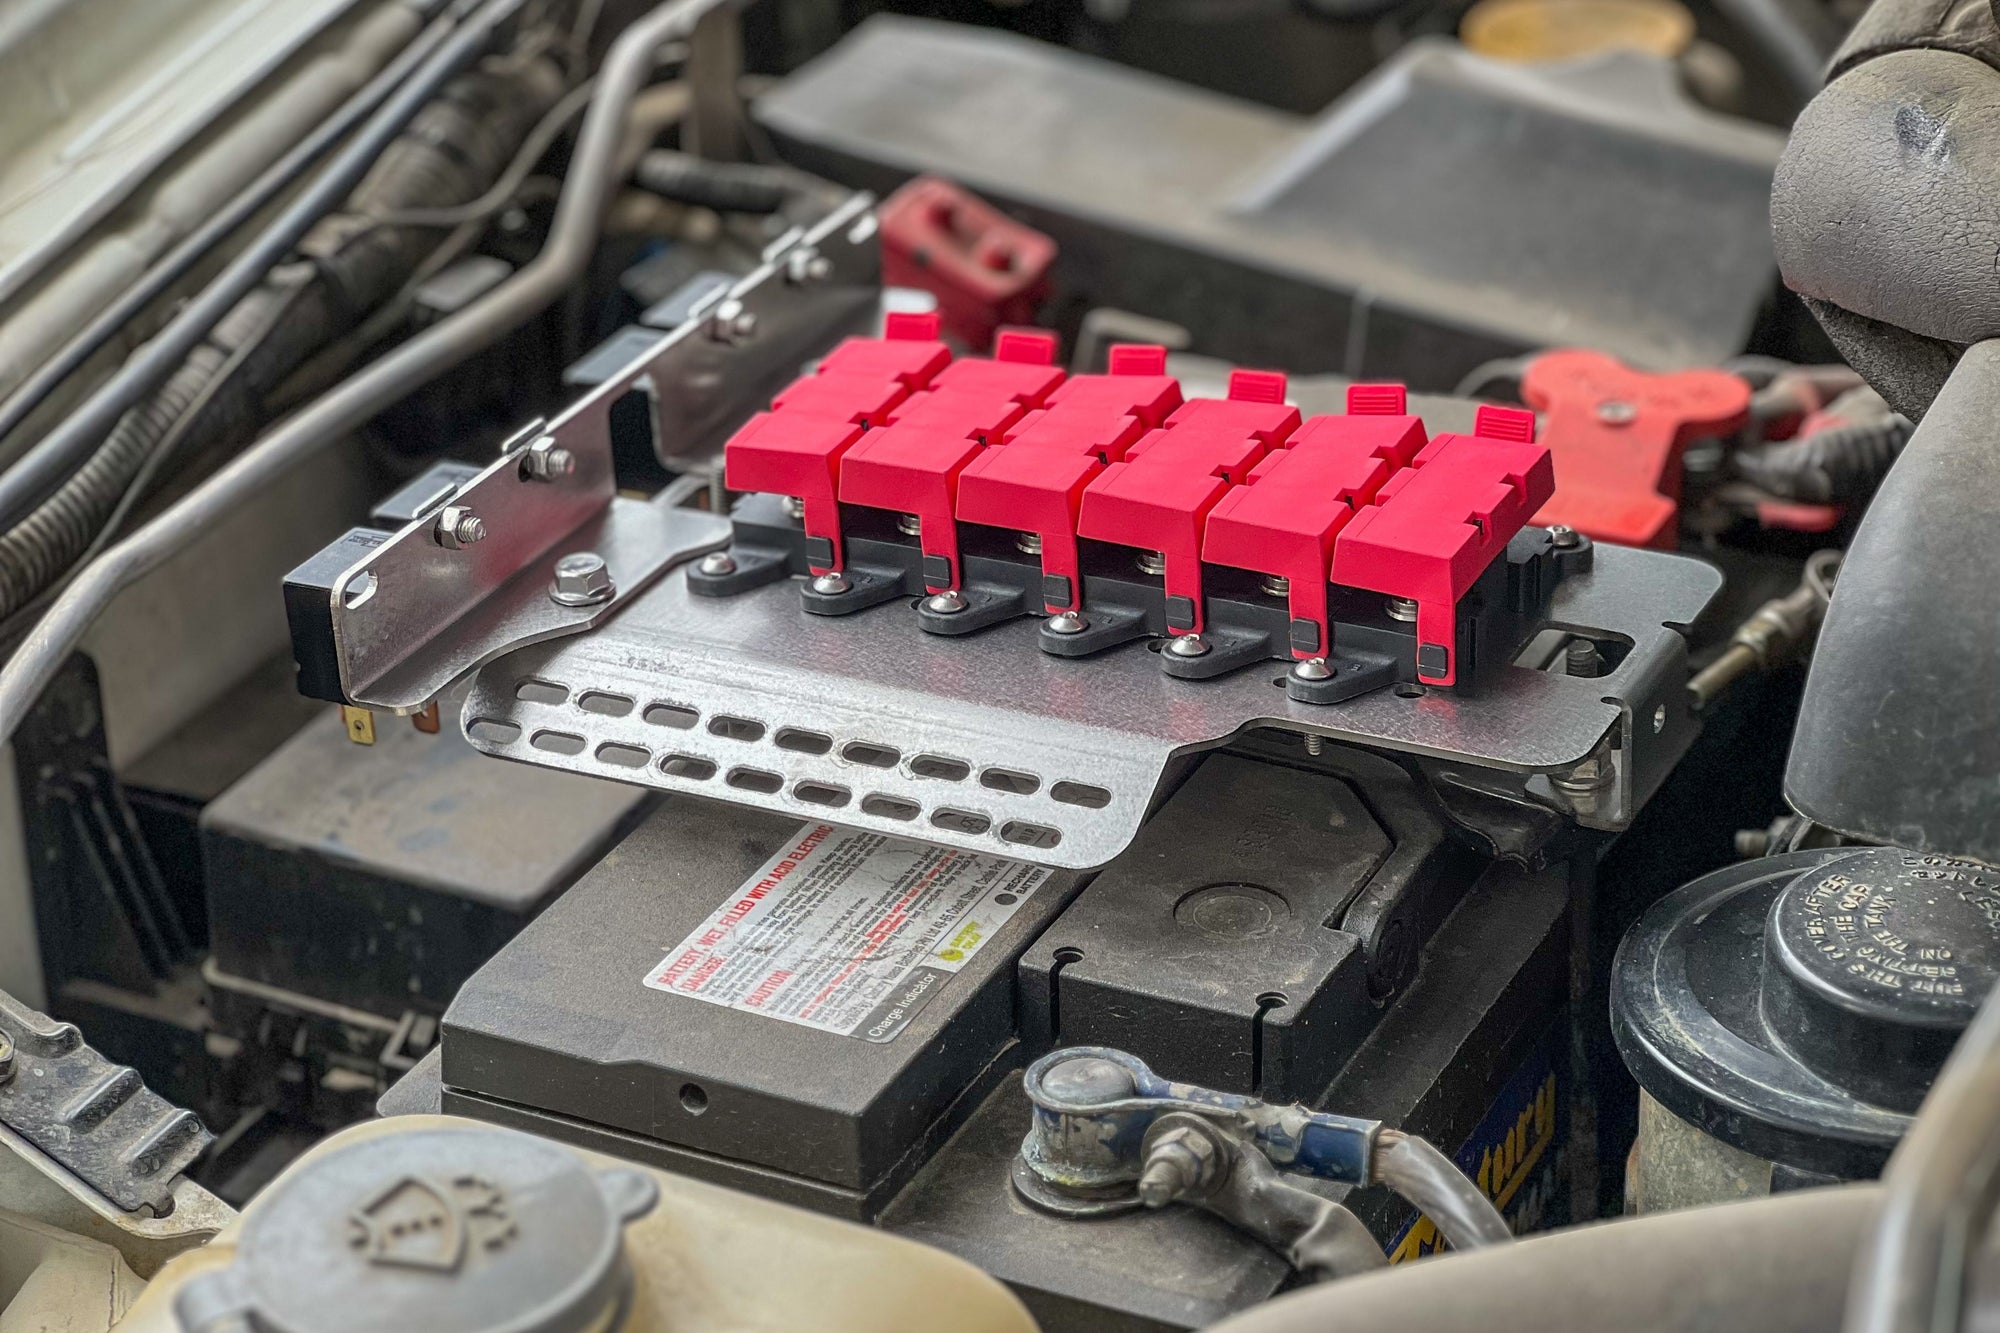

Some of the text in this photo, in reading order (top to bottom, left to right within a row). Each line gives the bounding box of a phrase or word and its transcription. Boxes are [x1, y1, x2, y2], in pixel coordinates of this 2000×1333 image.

[717, 899, 757, 926] FILLED
[744, 879, 778, 900] WITH
[765, 860, 798, 880] ACID
[786, 824, 835, 860] ELECTRIC
[765, 897, 790, 916] generate
[784, 878, 810, 897] explosive
[819, 852, 837, 863] Keep
[774, 908, 791, 919] from
[815, 861, 840, 879] charging
[791, 904, 807, 914] This
[801, 888, 822, 904] battery
[816, 871, 841, 889] contains
[814, 890, 832, 902] event
[831, 867, 856, 885] accident
[861, 846, 877, 856] with
[932, 873, 946, 882] the
[939, 859, 960, 874] battery
[1014, 869, 1046, 894] BATTERY
[828, 932, 852, 949] product
[850, 906, 878, 928] warranted
[871, 890, 894, 906] against
[887, 874, 910, 890] defects
[917, 846, 938, 860] period
[855, 914, 881, 935] purchase
[881, 893, 903, 908] private
[864, 918, 890, 938] Warranty
[888, 903, 905, 913] void
[892, 919, 914, 935] battery
[907, 910, 923, 919] test
[916, 887, 945, 910] procedure.
[930, 913, 956, 929] 49-65
[944, 898, 971, 914] Cobalt
[922, 927, 943, 937] Ltd
[1804, 873, 1965, 995] PUT THIS COVER AFTER
[1835, 883, 1957, 977] SETTING THE CAP
[1863, 894, 1953, 961] ON THE TANK
[865, 971, 939, 1038] Charge Indicator
